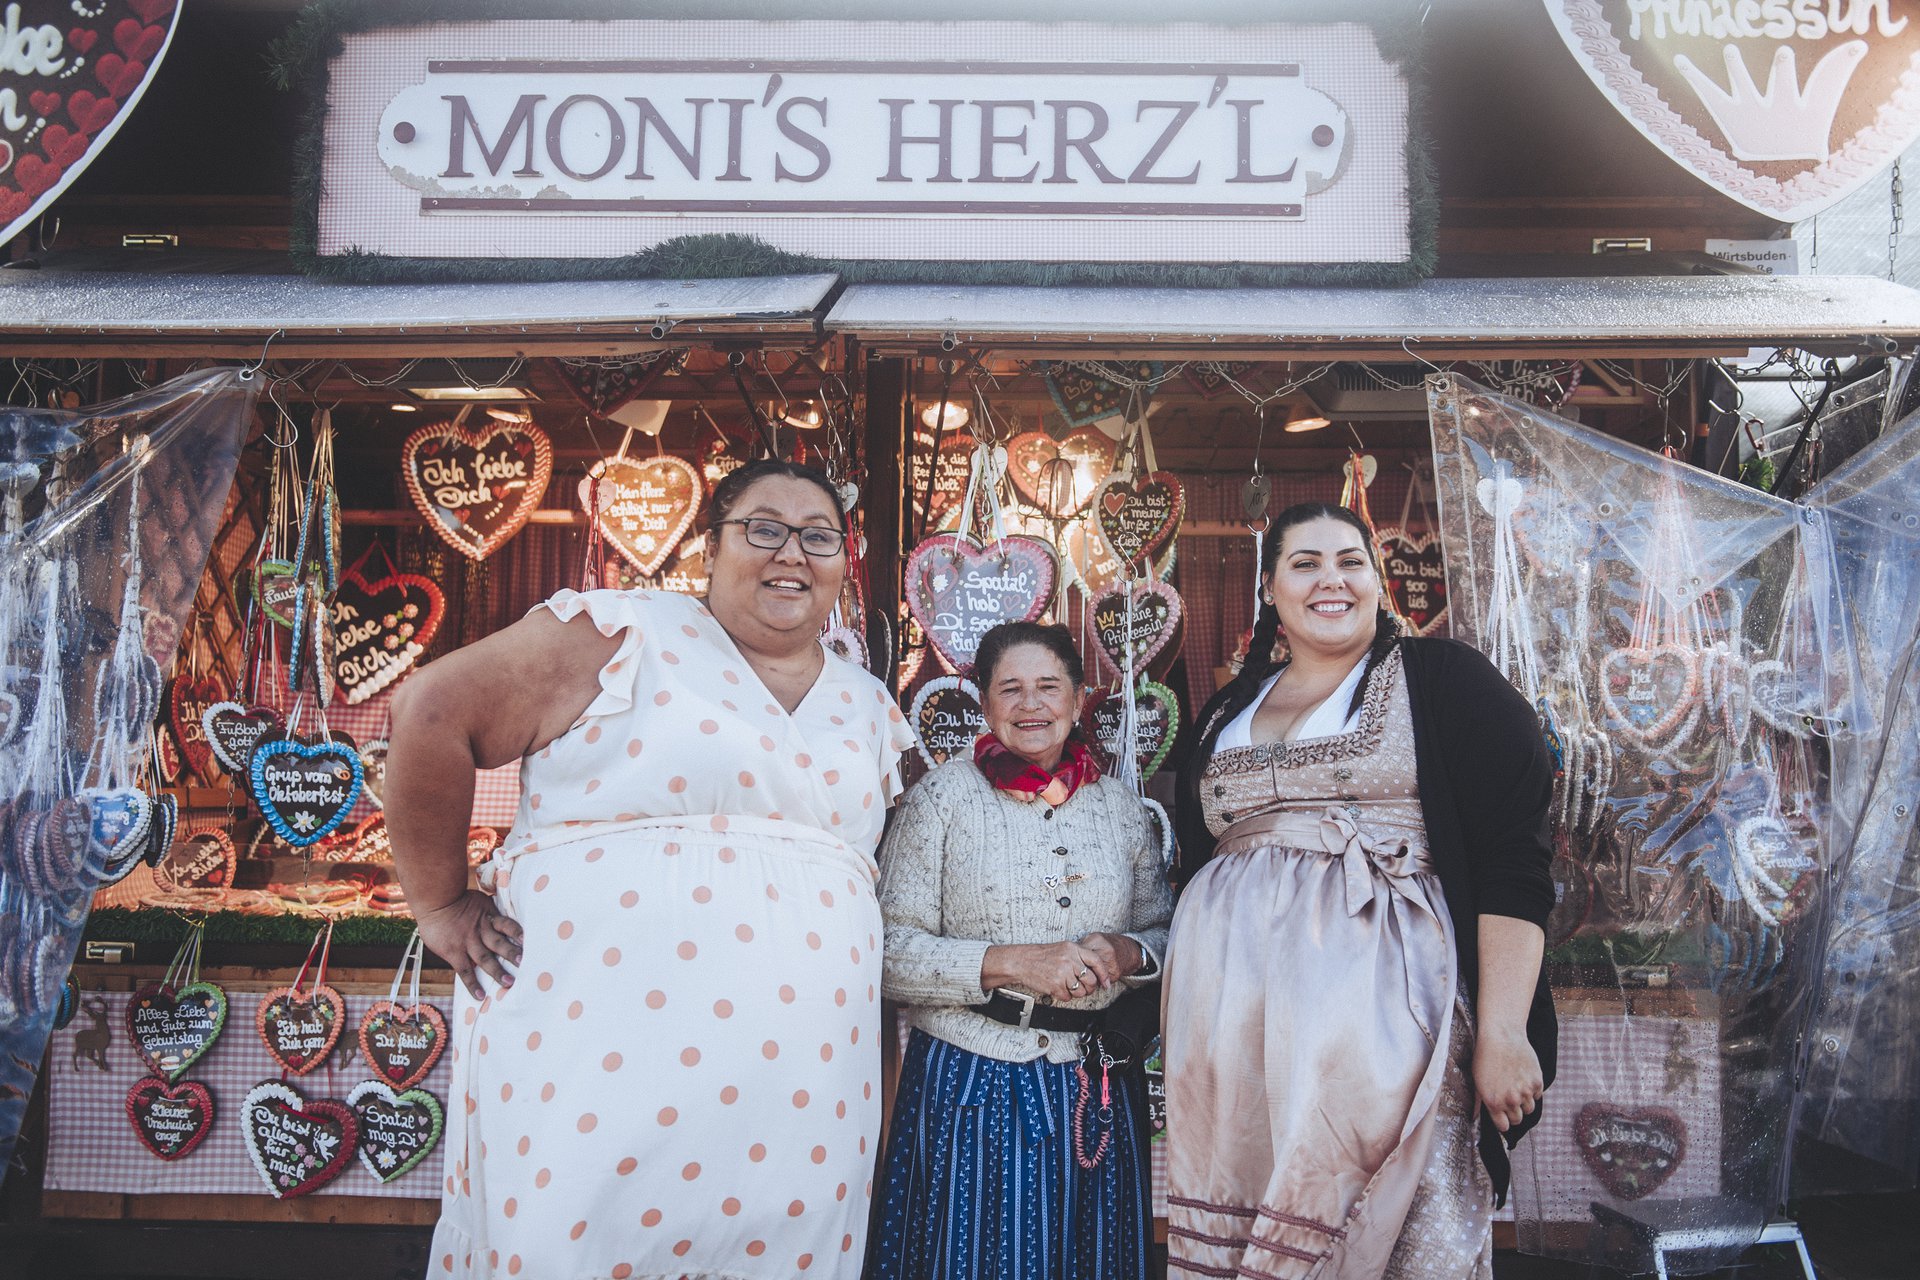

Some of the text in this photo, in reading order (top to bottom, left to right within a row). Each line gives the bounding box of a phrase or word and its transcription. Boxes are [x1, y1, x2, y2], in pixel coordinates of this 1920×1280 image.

[441, 72, 1299, 185] MONI'S HERZ'L
[423, 451, 527, 486] Ich liebe
[950, 453, 968, 465] die
[434, 479, 493, 509] Dich
[934, 477, 960, 491] Welt
[1125, 494, 1166, 508] Du bist
[641, 515, 668, 531] Dich
[1131, 507, 1162, 519] meine
[1390, 559, 1444, 578] Du bist
[264, 581, 298, 604] Laus
[966, 590, 1001, 612] hob
[1407, 594, 1429, 609] lieb
[932, 613, 968, 632] Di
[335, 619, 382, 656] iebe
[339, 646, 397, 685] Dich
[932, 708, 985, 731] Du bis
[1094, 709, 1116, 724] Von
[216, 718, 268, 738] Fußball
[264, 765, 332, 788] Gruß vom
[268, 783, 346, 807] Oktoberfest
[135, 1004, 206, 1022] Alles Liebe
[136, 1021, 159, 1034] und
[188, 1018, 215, 1030] zum
[276, 1019, 323, 1036] Ich hab
[142, 1033, 205, 1050] Geburtstag
[278, 1036, 326, 1056] Dich gern
[375, 1032, 429, 1054] Du fehlst
[388, 1052, 411, 1066] uns
[151, 1103, 195, 1119] Kleiner
[251, 1105, 311, 1136] Du bist
[155, 1131, 182, 1146] engel
[263, 1138, 290, 1158] für
[367, 1128, 419, 1148] mog Di
[269, 1157, 306, 1182] mich
